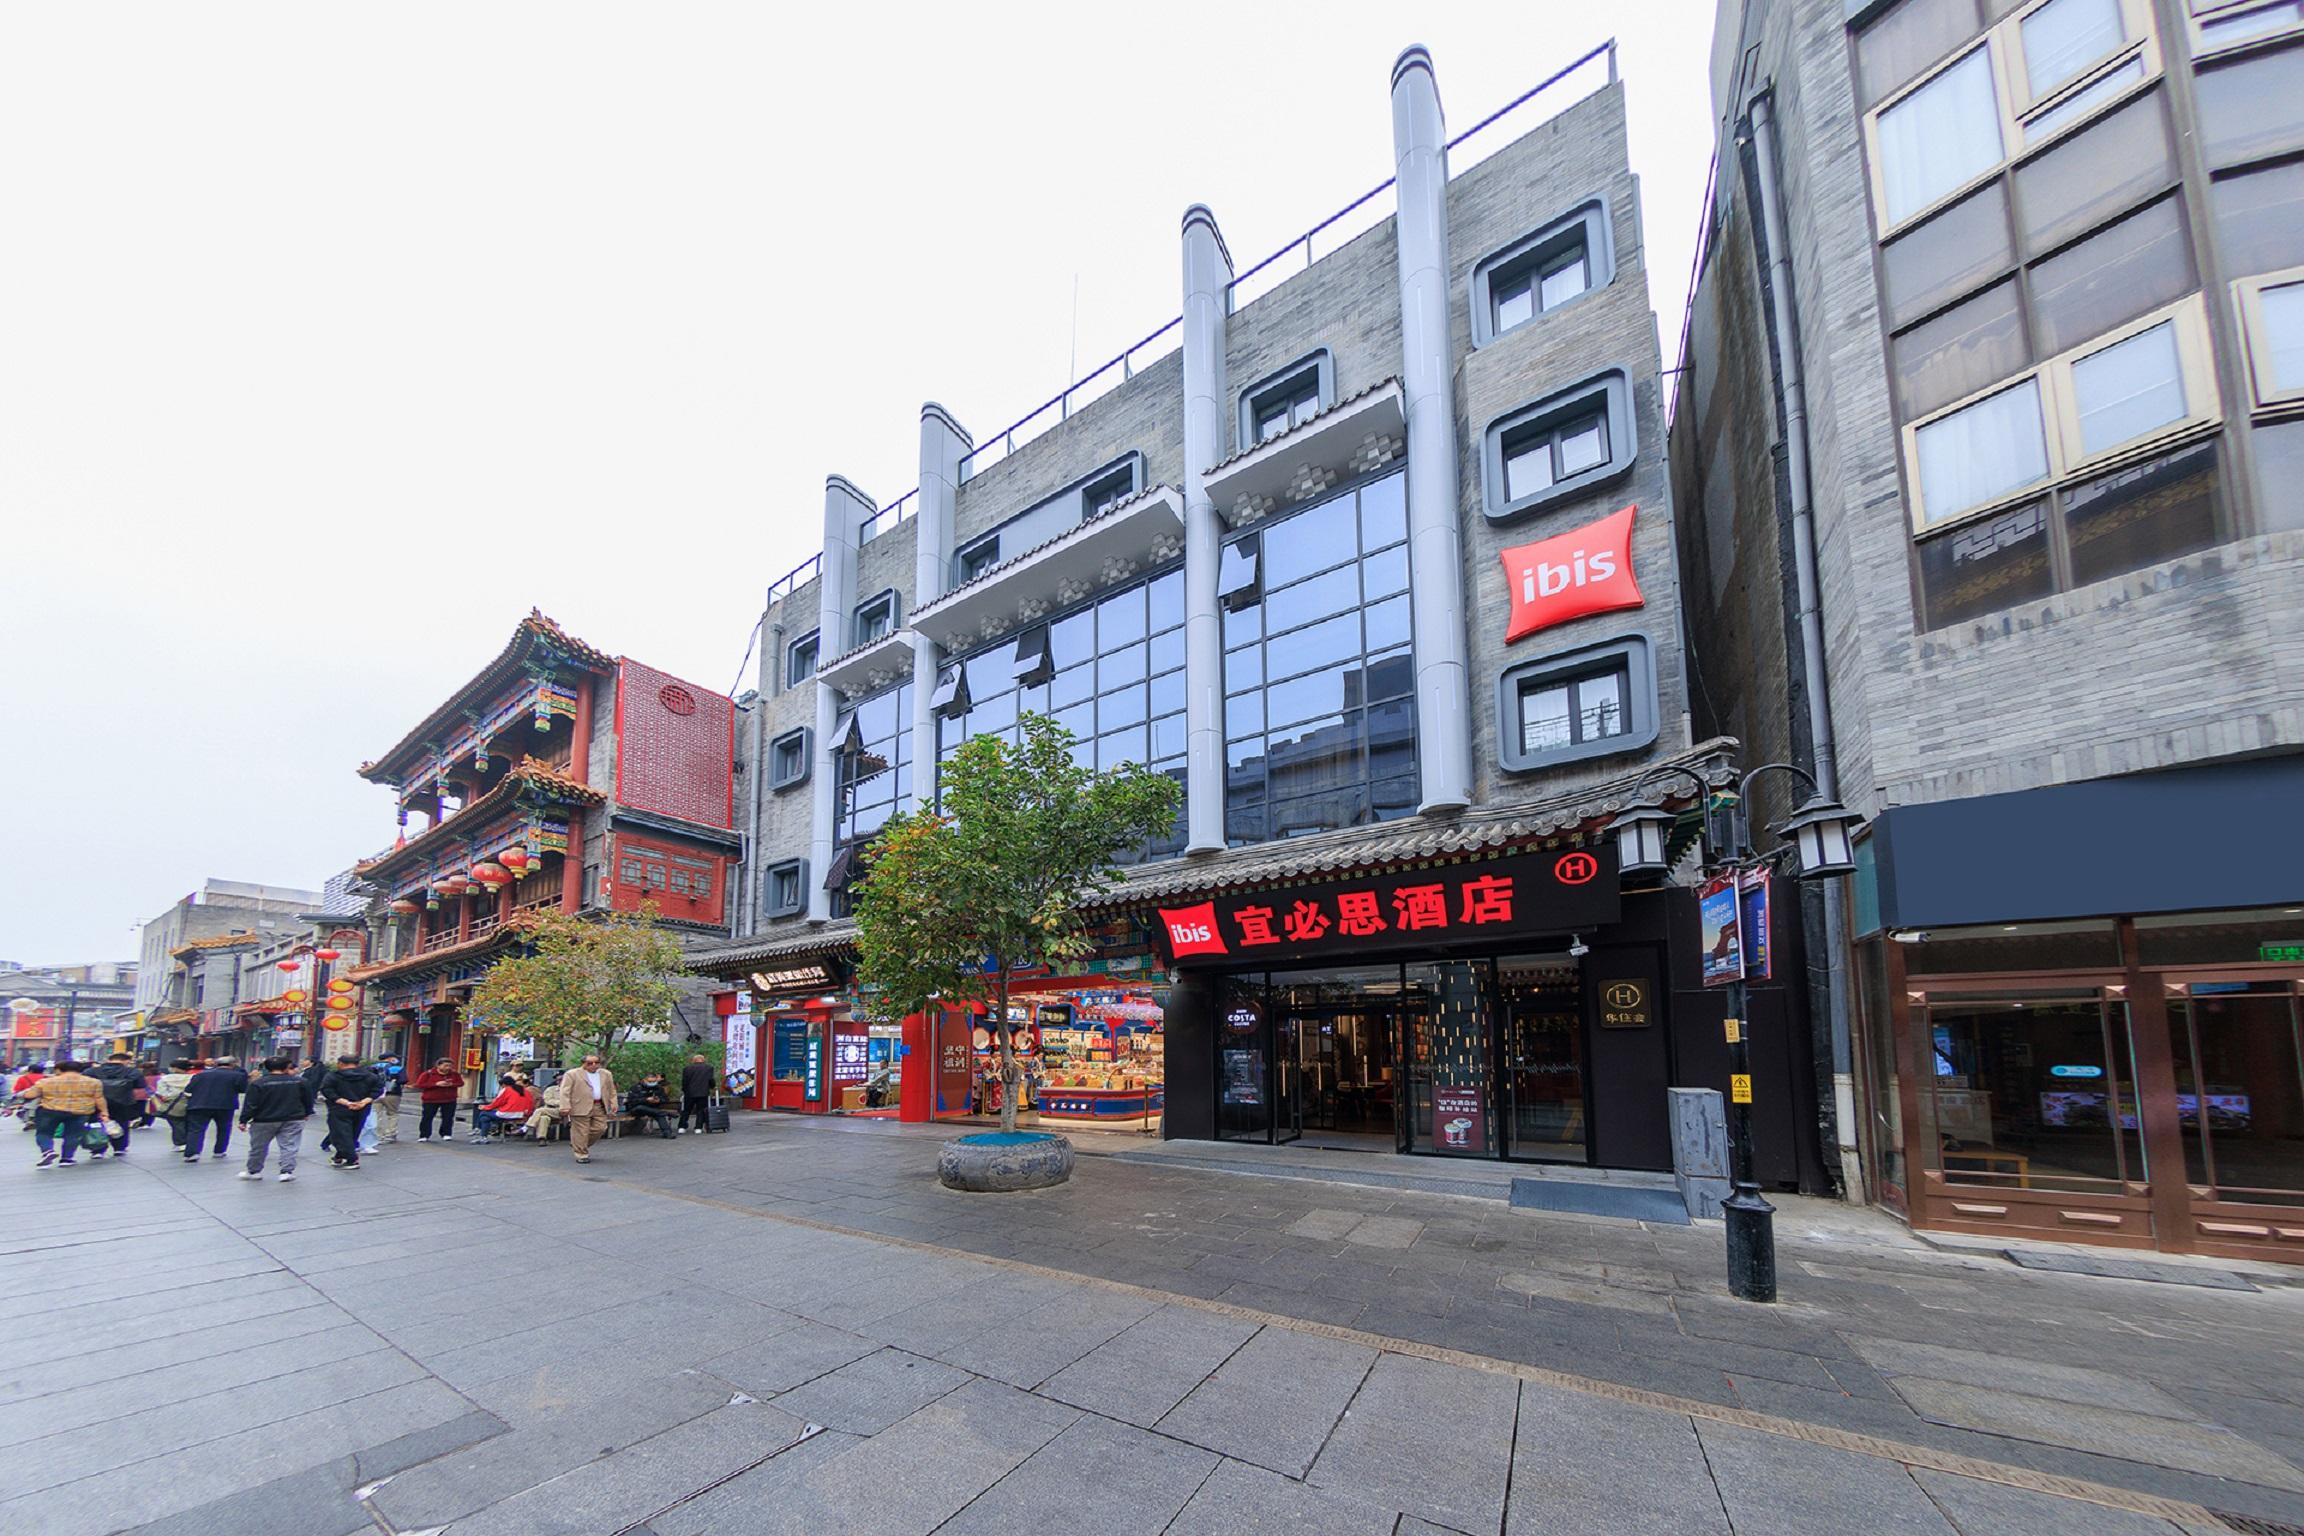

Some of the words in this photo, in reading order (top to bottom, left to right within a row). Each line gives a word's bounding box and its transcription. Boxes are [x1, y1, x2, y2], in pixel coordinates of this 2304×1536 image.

[1523, 550, 1616, 604] ibis
[1233, 874, 1513, 947] 宜必思酒店
[1171, 923, 1211, 944] ibis
[1227, 1014, 1256, 1022] COSTA
